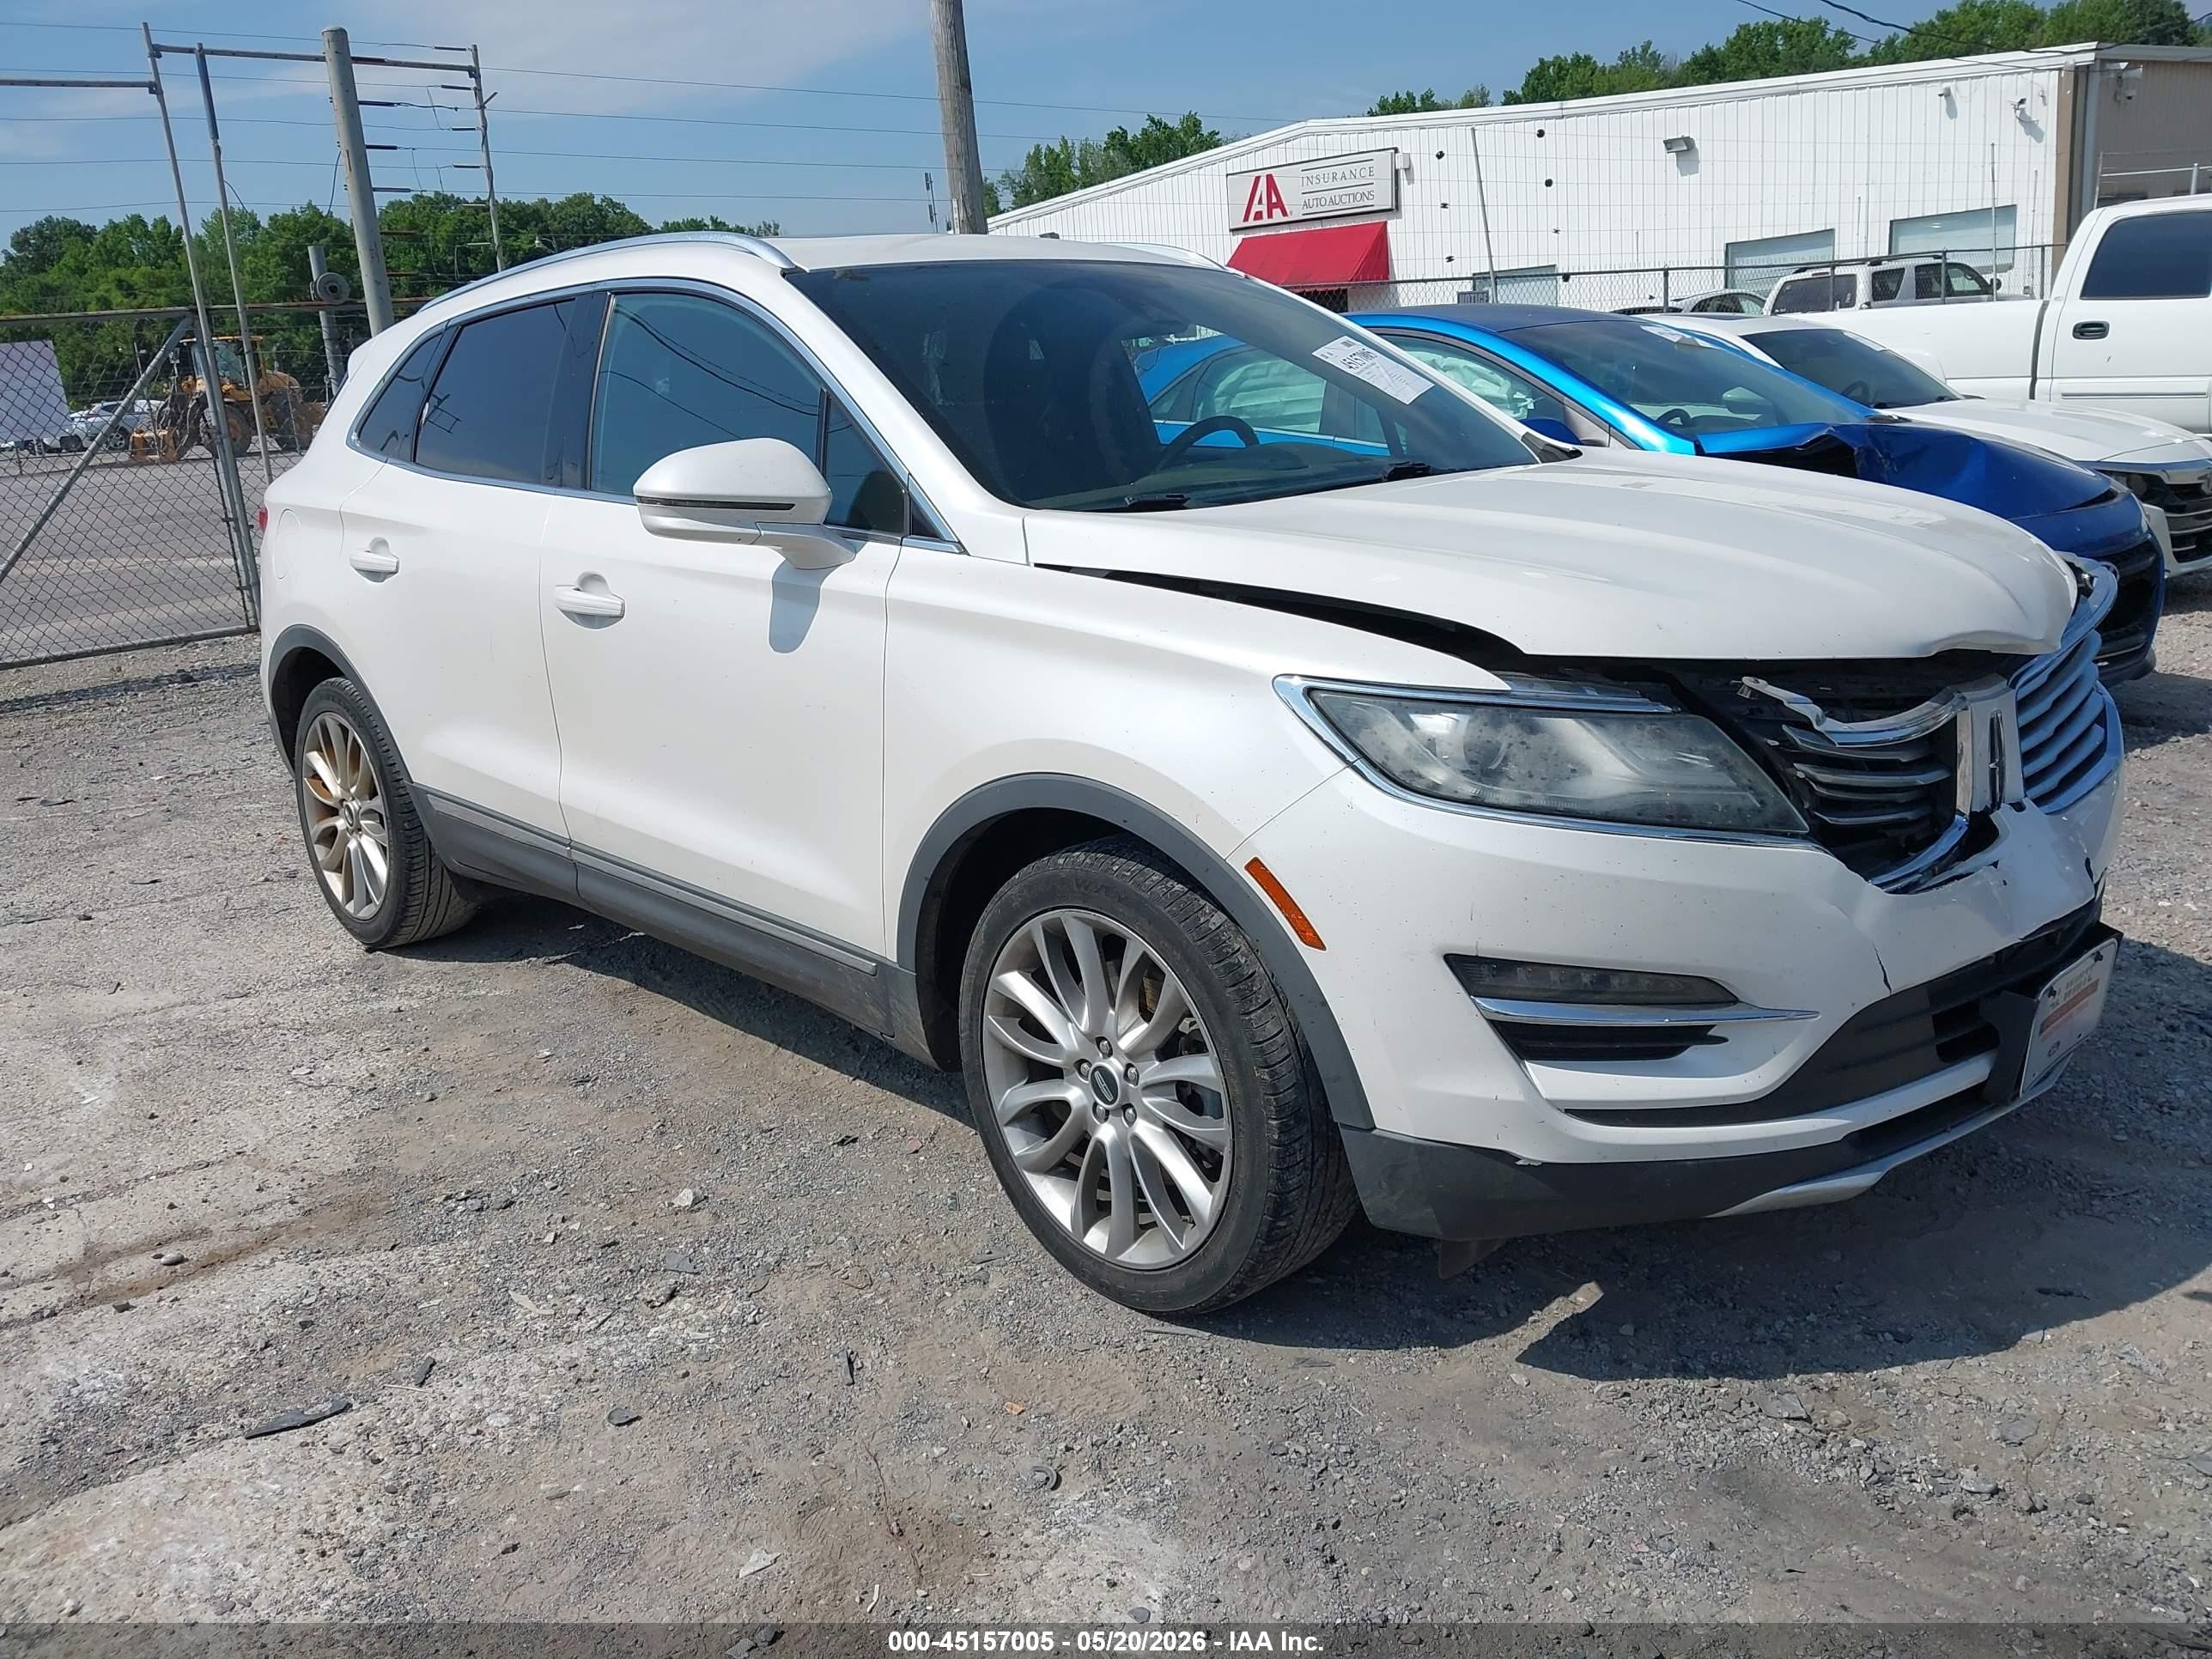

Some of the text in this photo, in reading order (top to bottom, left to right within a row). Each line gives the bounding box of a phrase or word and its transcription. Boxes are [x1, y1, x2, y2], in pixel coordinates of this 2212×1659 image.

[1301, 166, 1375, 186] INSURANCE
[1302, 190, 1375, 210] AUTO AUCTIONS
